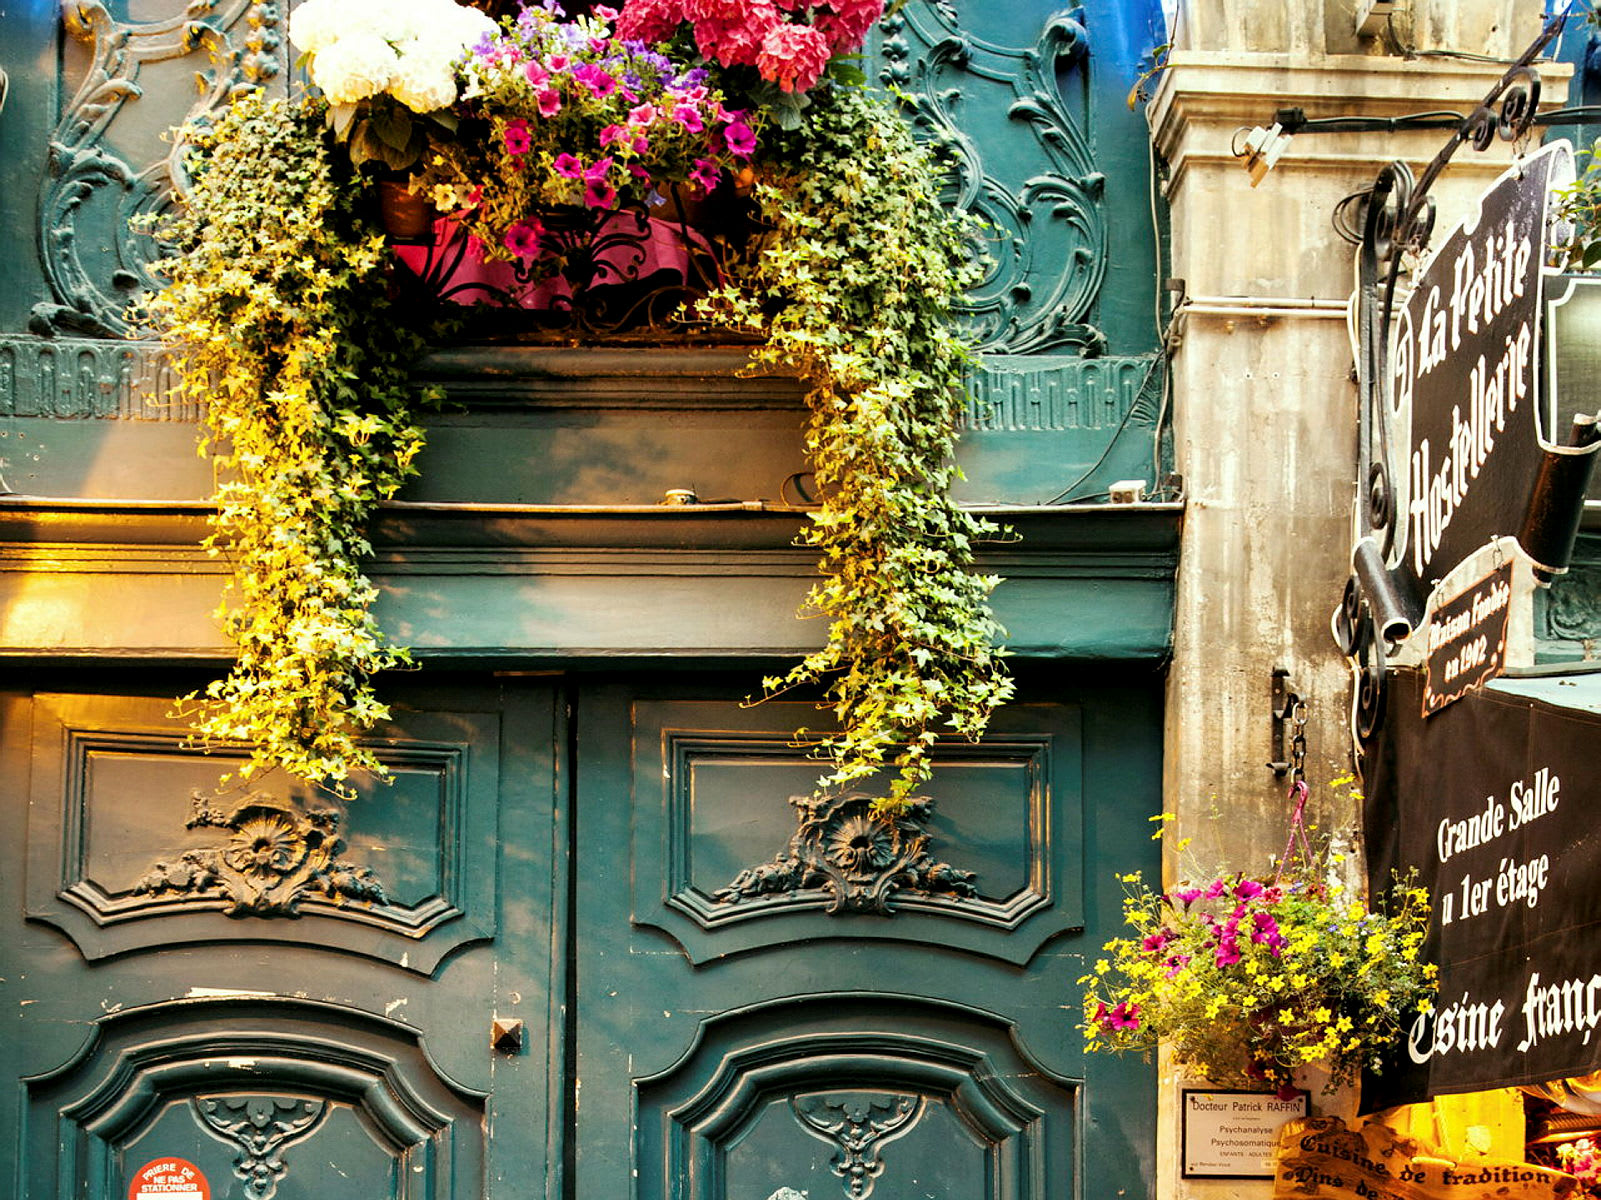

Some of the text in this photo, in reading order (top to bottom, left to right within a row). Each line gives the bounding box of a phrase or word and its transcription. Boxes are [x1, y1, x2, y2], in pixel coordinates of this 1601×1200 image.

[1417, 219, 1532, 379] La Petite
[1410, 321, 1531, 578] Hostellerie
[1429, 610, 1471, 657] Maison
[1444, 633, 1487, 683] en 1902
[1437, 767, 1560, 863] Grande Salle
[1442, 853, 1549, 926] u 1er étage
[1192, 1101, 1301, 1112] Docteur Patrick RAFFIN
[1219, 1126, 1273, 1135] Psychanalyse
[142, 1163, 196, 1181] PRIERE DE
[153, 1175, 186, 1184] NE PAS
[1294, 1164, 1344, 1188] Vins
[1300, 1135, 1551, 1186] Cuisine de tradition
[141, 1183, 198, 1193] STATIONNER
